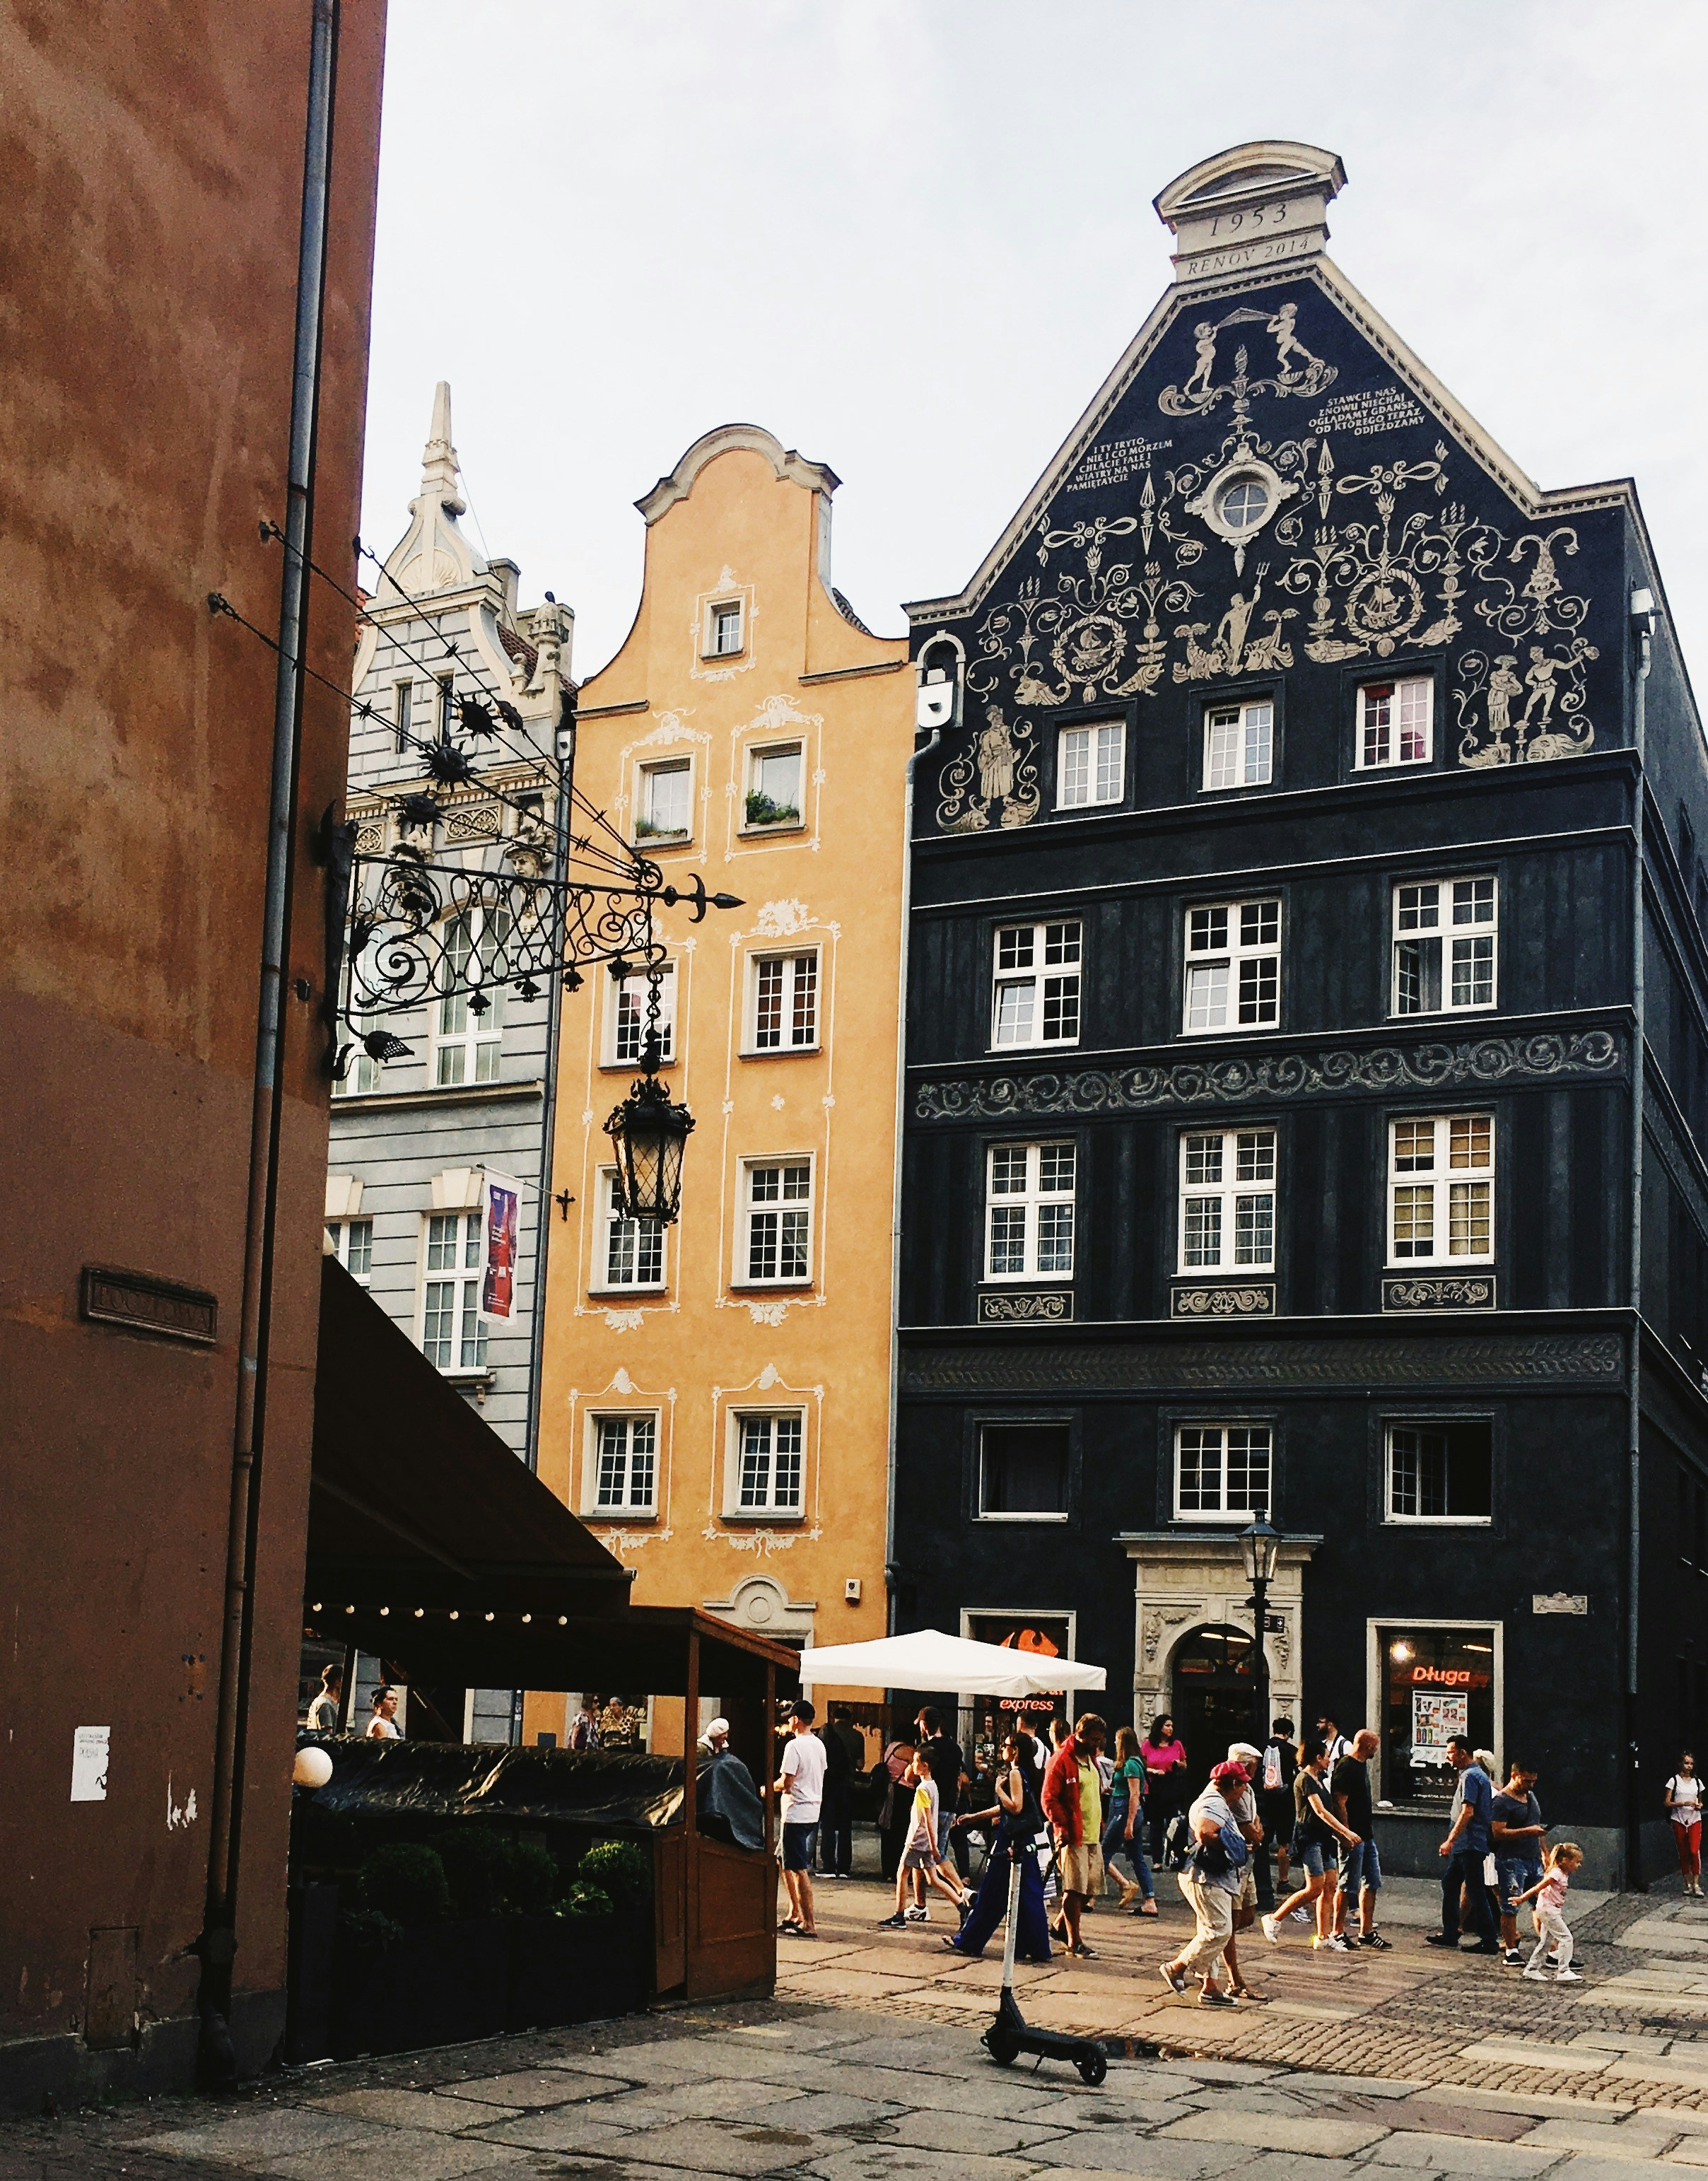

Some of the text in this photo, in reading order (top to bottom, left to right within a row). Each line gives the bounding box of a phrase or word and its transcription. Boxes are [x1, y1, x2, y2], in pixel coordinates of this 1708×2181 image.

[1210, 204, 1287, 237] 1953
[1188, 238, 1309, 275] RENOV 2014
[1327, 386, 1397, 407] STAWCIE NAS
[1319, 402, 1358, 417] ZNOWU
[1315, 425, 1331, 435] OD
[1387, 407, 1421, 421] TERAZ
[1087, 454, 1103, 464] NIE
[1111, 450, 1127, 459] CO
[1100, 443, 1112, 452] TY
[1123, 453, 1145, 464] FALE
[1075, 460, 1152, 482] WIATRY NA NAS
[1412, 1666, 1470, 1685] Długa
[1000, 1699, 1055, 1712] express
